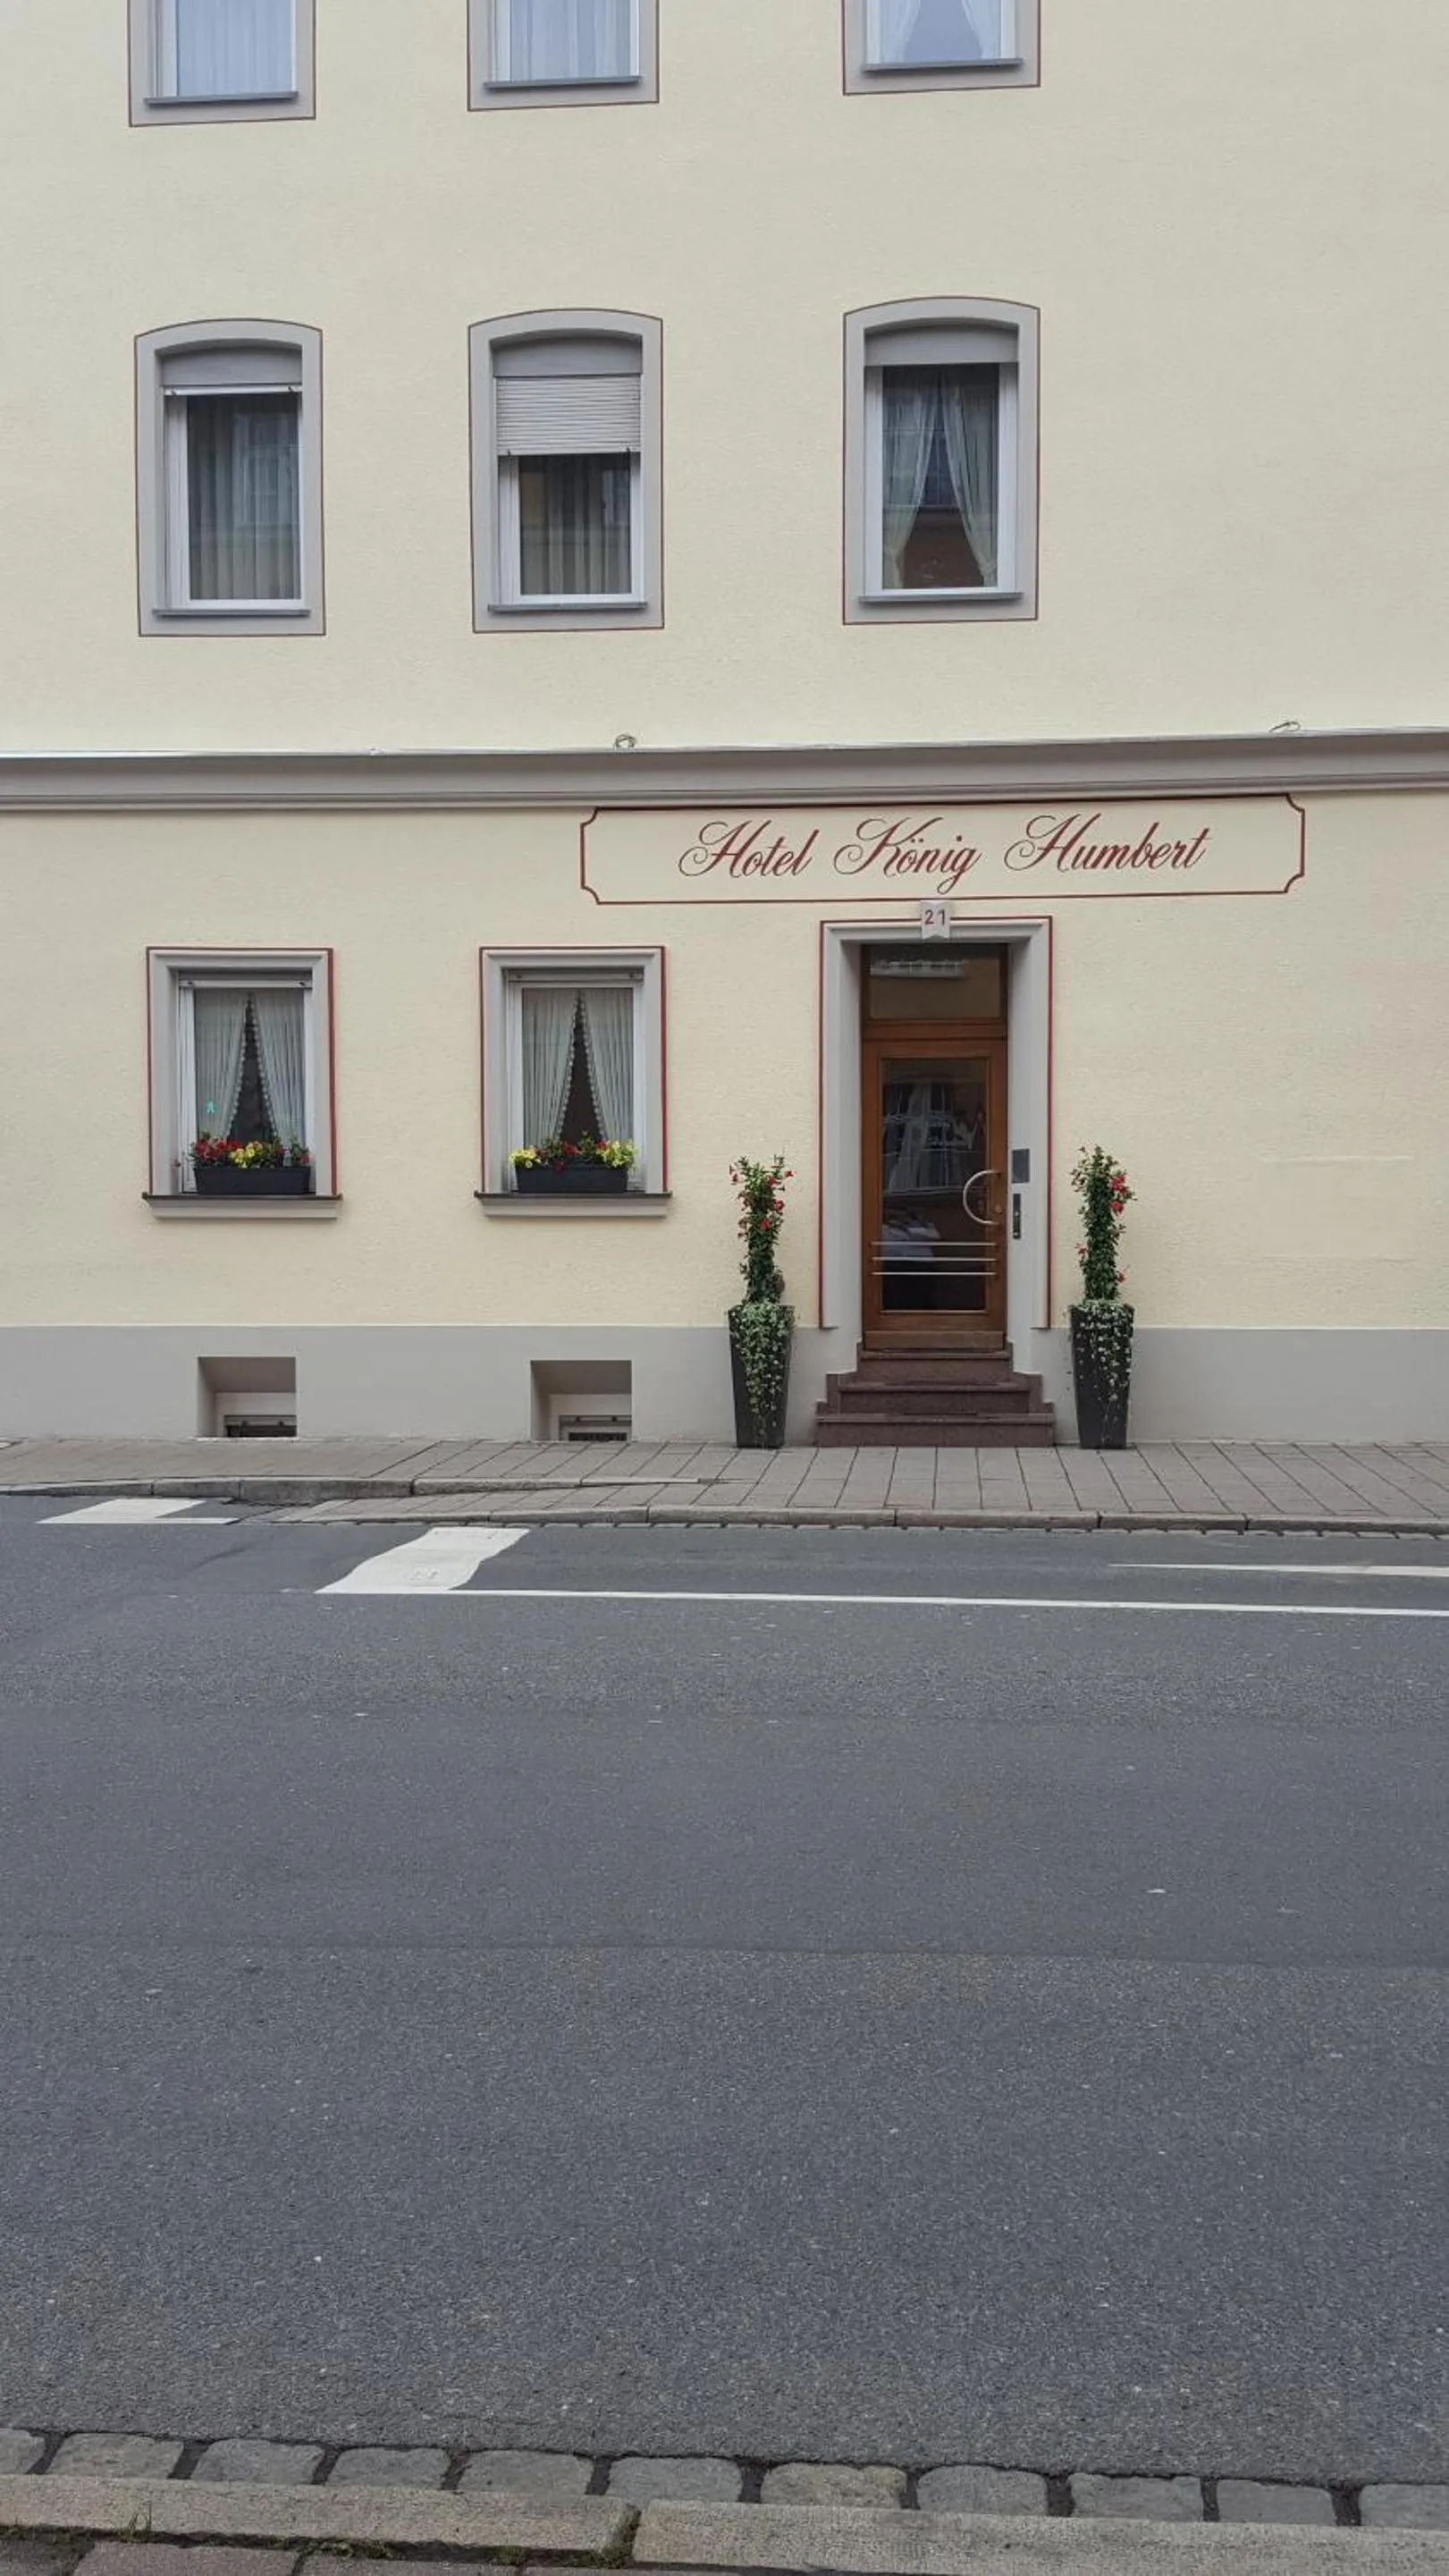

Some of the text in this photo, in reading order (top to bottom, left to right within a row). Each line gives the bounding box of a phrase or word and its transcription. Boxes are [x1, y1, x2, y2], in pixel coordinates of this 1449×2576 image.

[678, 813, 1211, 893] Hotel König Humbert
[925, 908, 945, 926] 21
